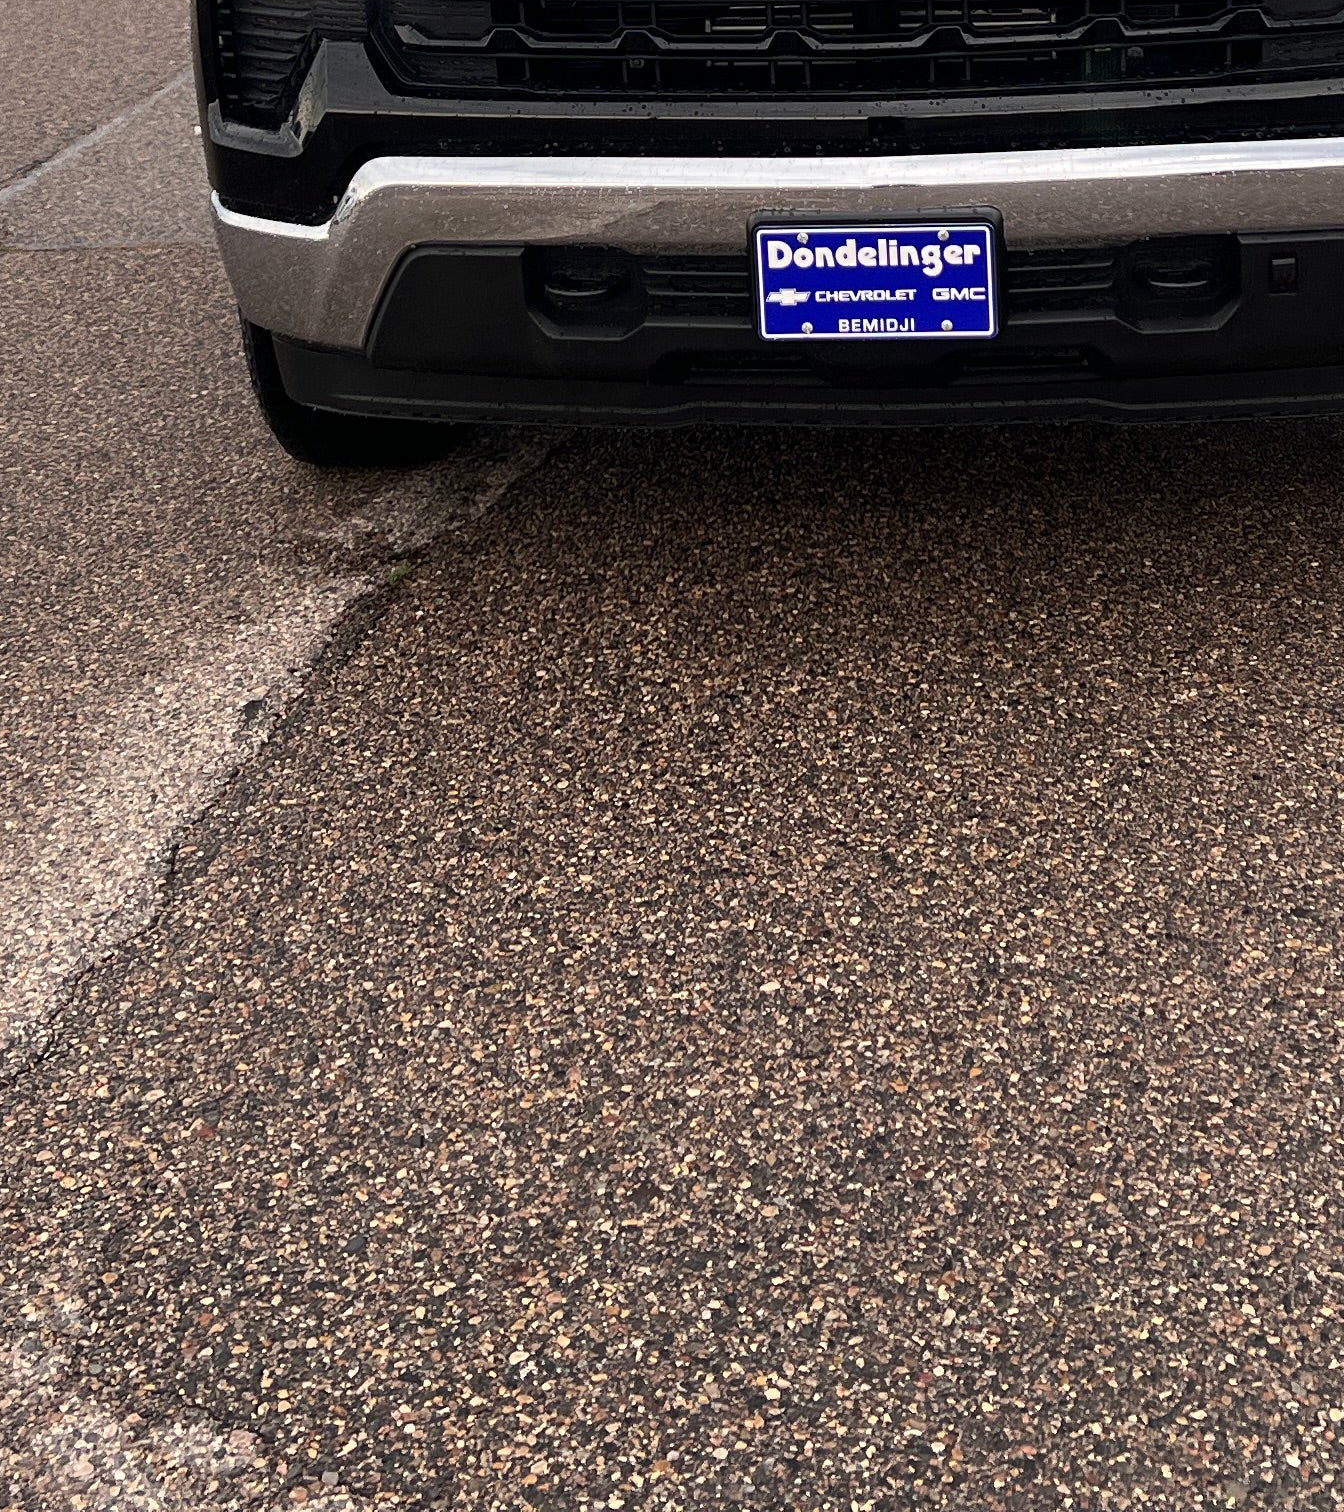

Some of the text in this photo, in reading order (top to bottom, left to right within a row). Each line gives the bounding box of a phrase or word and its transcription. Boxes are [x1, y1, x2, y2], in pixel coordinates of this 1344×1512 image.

[767, 239, 981, 277] Dondelinger
[814, 287, 987, 303] CHEVROLET GMC
[838, 317, 916, 333] BEMIDJI
